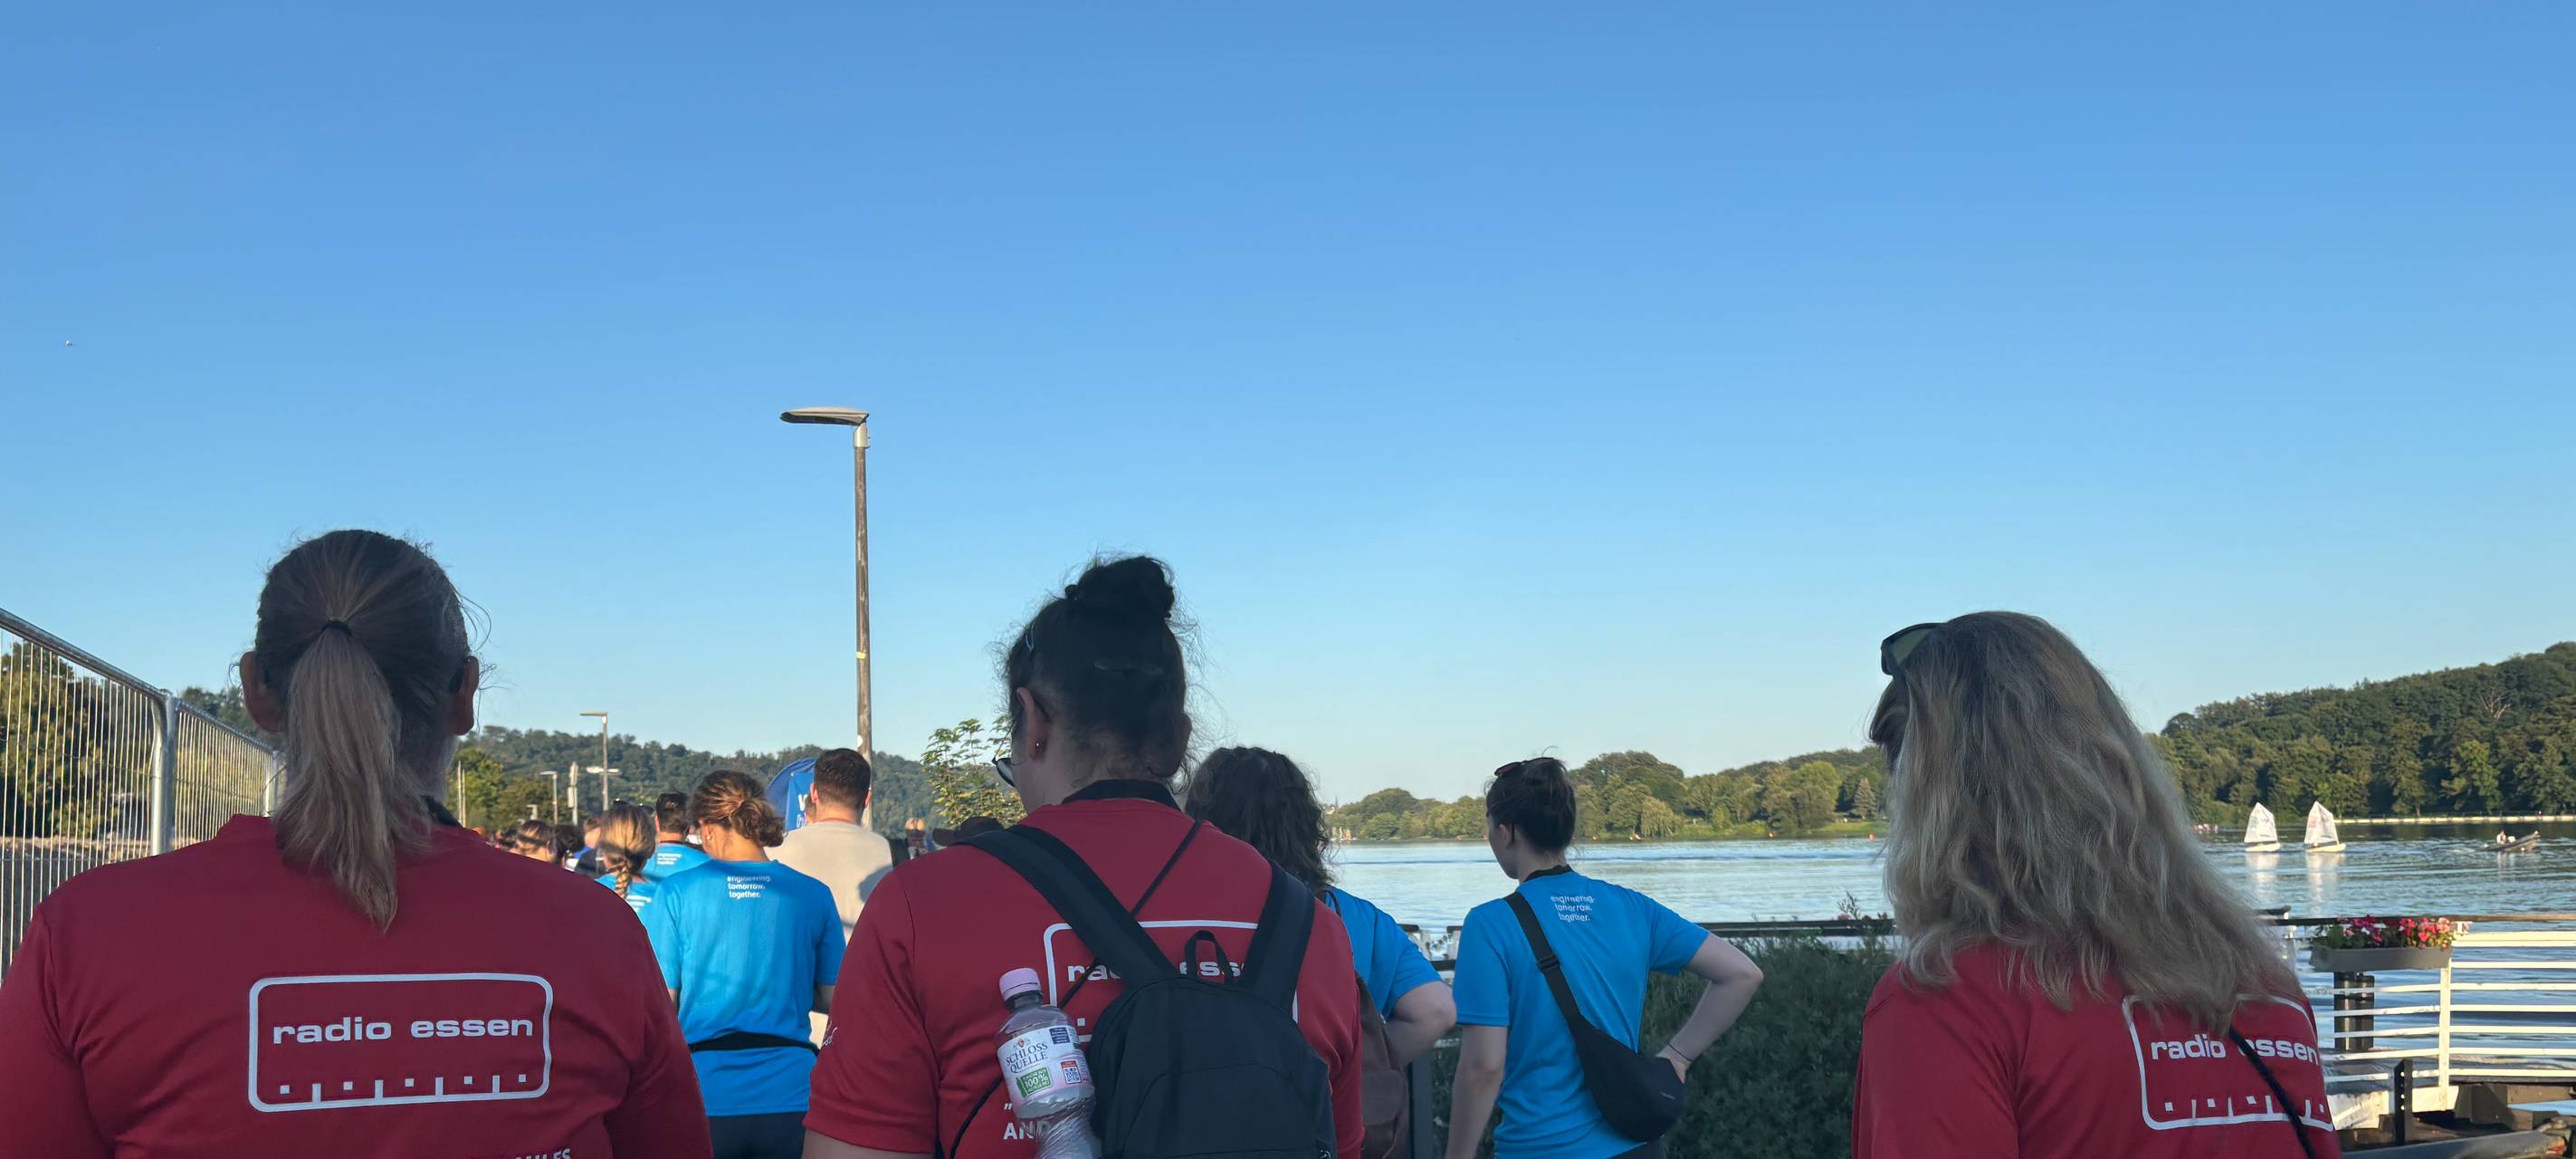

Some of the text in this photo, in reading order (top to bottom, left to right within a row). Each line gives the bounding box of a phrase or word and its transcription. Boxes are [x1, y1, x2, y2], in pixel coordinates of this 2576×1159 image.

[729, 891, 761, 899] together.
[273, 1016, 534, 1044] radio essen
[1006, 1042, 1048, 1067] SCHLOSS
[2151, 1033, 2227, 1060] radio
[1009, 1051, 1048, 1074] QUELLE
[1025, 1074, 1049, 1089] 100%
